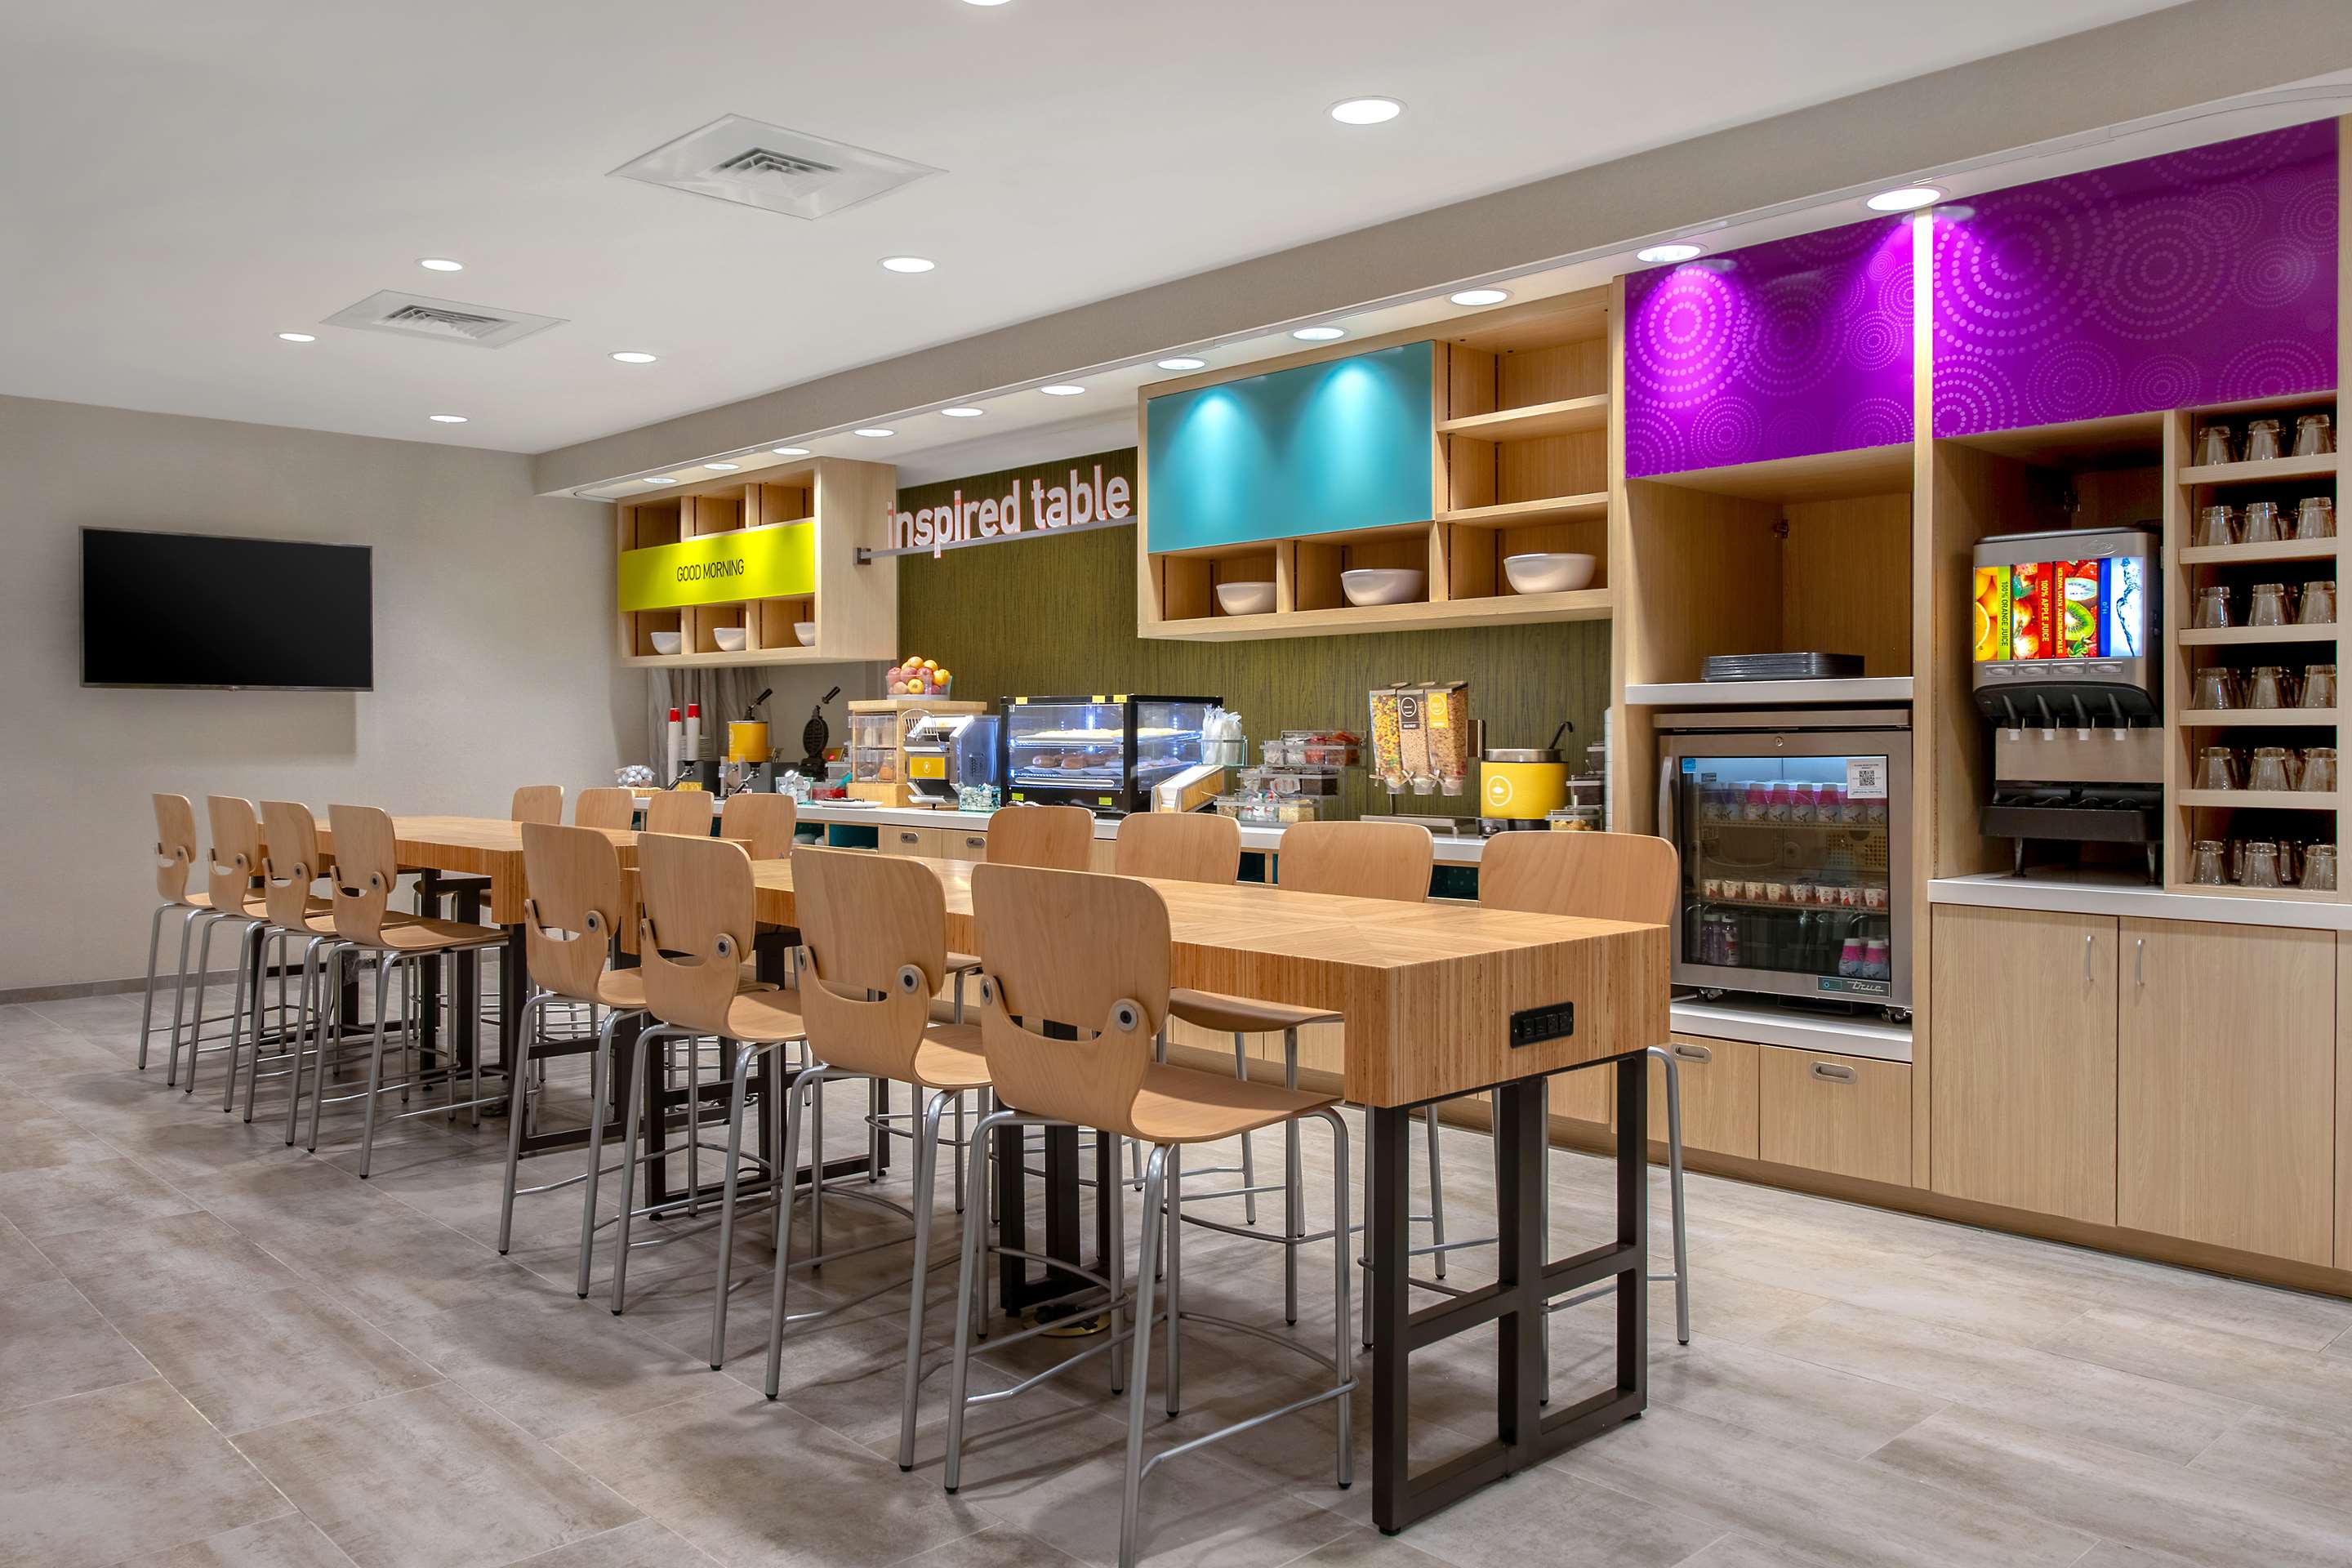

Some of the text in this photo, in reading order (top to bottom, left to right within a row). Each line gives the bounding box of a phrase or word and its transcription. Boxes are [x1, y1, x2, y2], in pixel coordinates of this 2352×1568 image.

[887, 464, 1131, 559] inspired table
[676, 559, 745, 582] GOOD MORNING
[2001, 581, 2009, 647] 100% ORANGE JUICE
[2040, 580, 2050, 642] 100% APPLE JUICE
